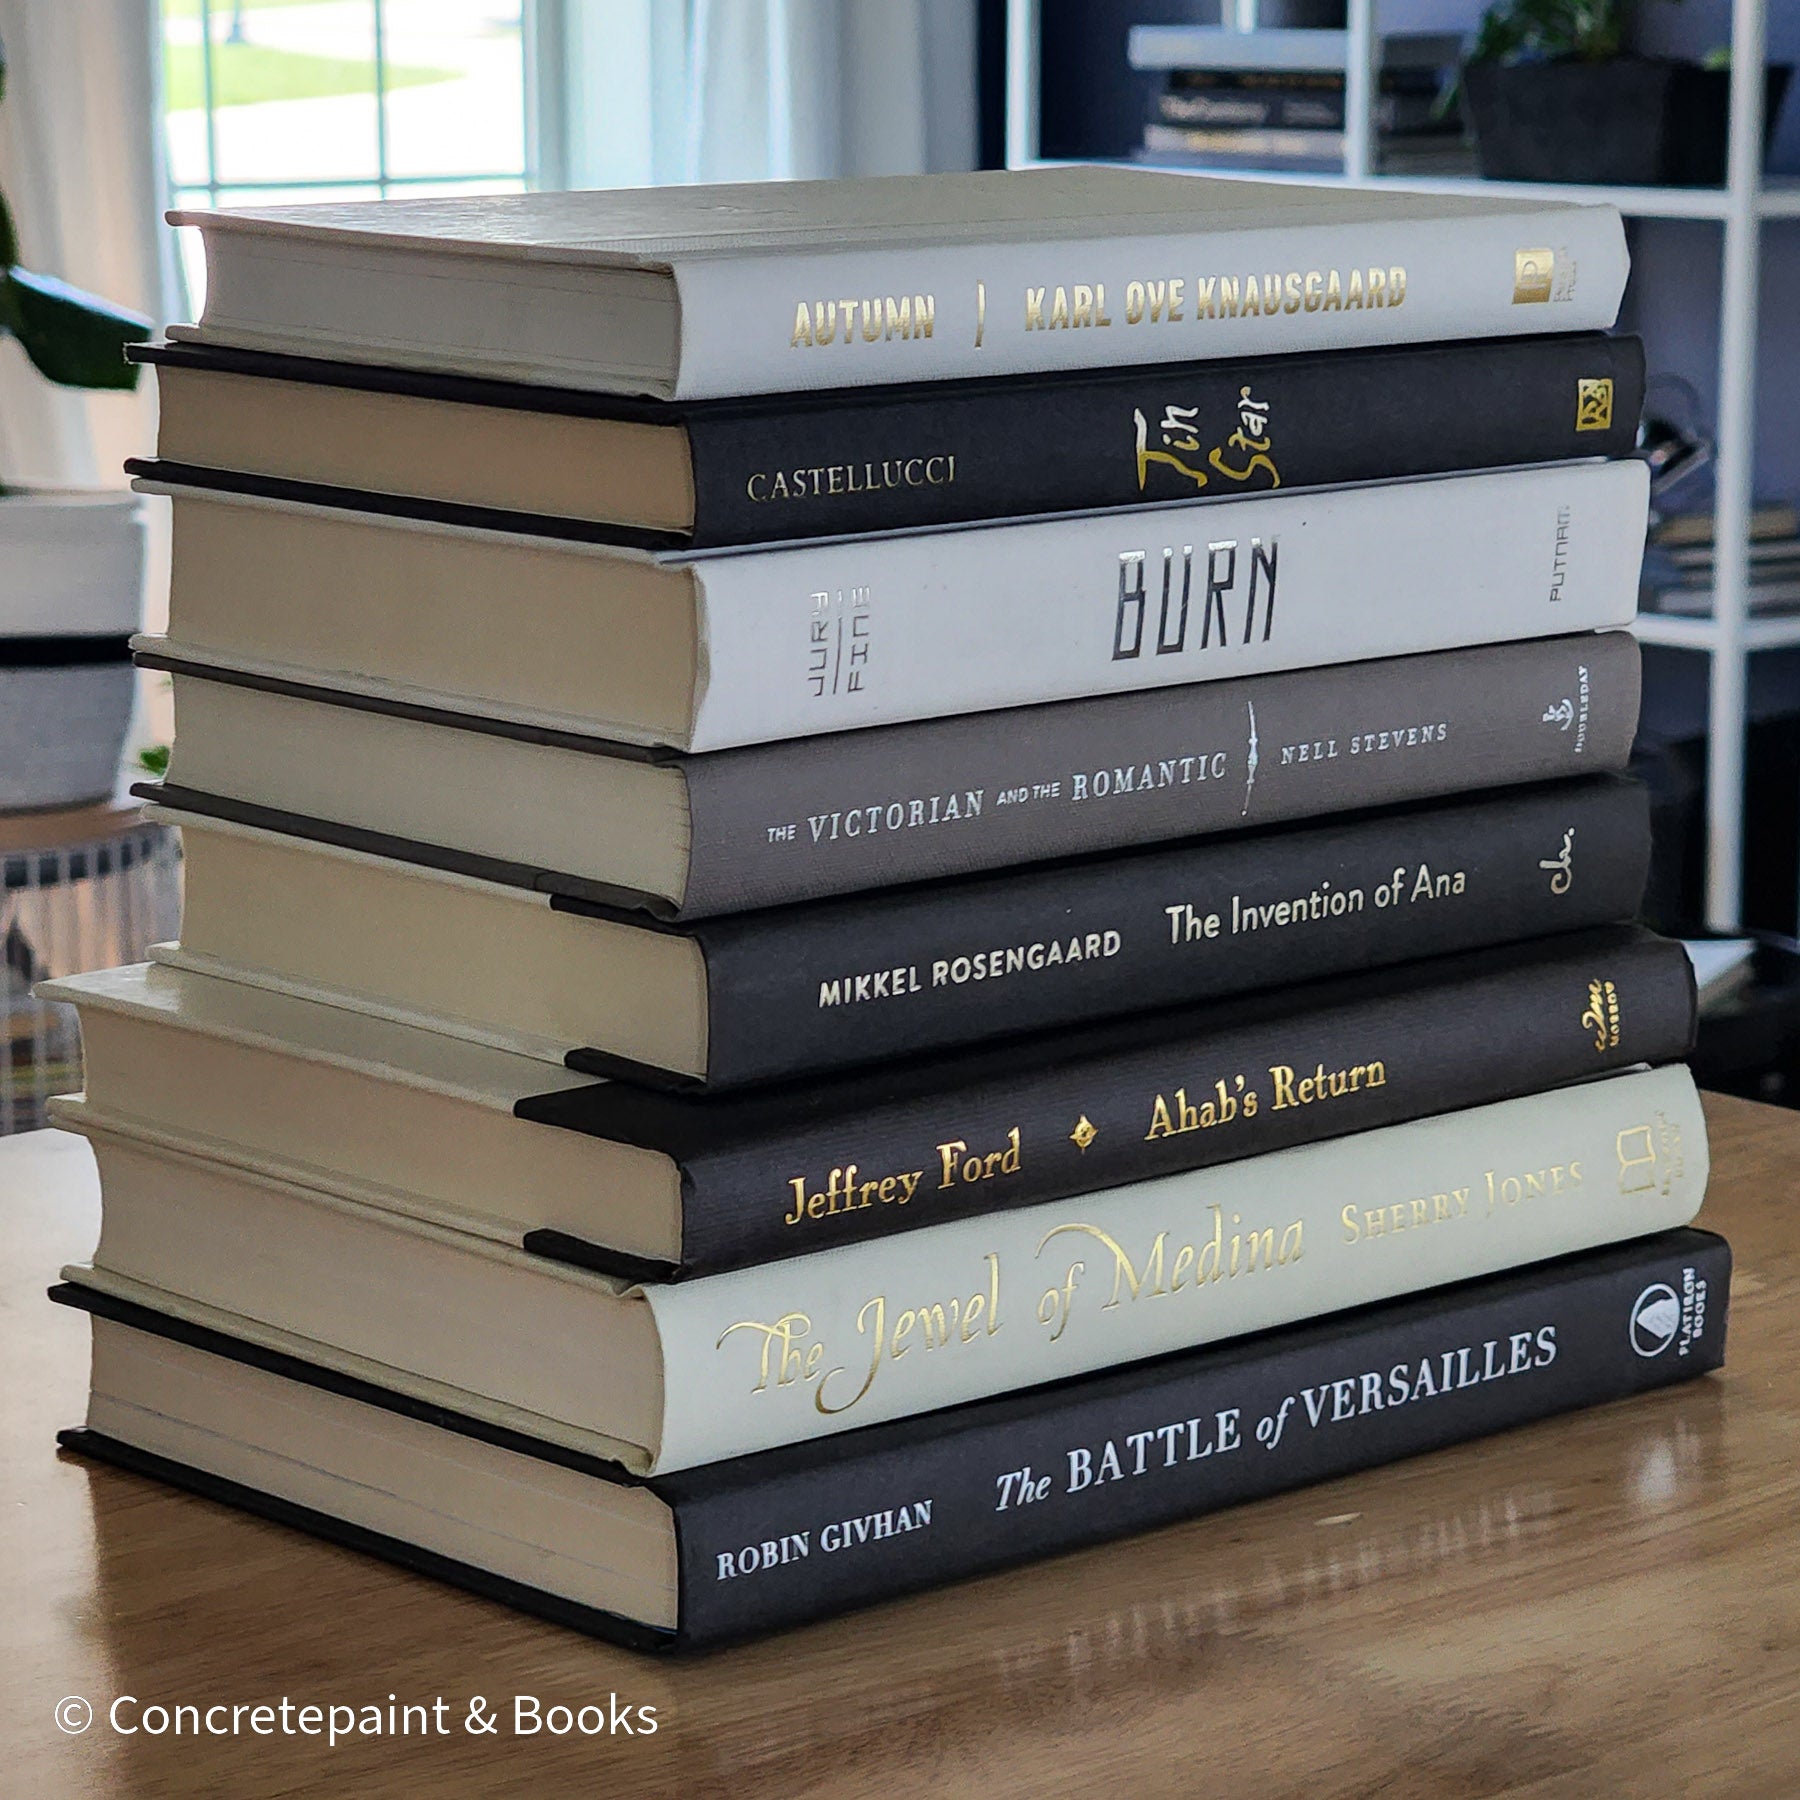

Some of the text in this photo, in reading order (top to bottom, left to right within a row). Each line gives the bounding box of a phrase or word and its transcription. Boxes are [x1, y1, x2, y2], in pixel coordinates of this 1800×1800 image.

[790, 294, 936, 349] AUTUMN
[1024, 266, 1408, 332] KARL OVE KNAUSGAARD
[1133, 404, 1208, 491] Tin
[1208, 386, 1281, 489] Star
[746, 455, 955, 502] CASTELLUCCI
[1111, 534, 1281, 662] BURN
[1280, 722, 1449, 766] NELL STEVENS
[767, 752, 1229, 843] THE VICTORIAN AND THE ROMANTIC
[1165, 864, 1467, 945] The Invention of Ana
[818, 930, 1123, 1009] MIKKEL ROSENGAARD
[1144, 1060, 1387, 1141] Ahab's Return
[784, 1126, 1022, 1226] Jeffrey Ford
[716, 1203, 1305, 1415] The Jewel of Medina
[995, 1326, 1557, 1511] The BATTLE of VERSAILLES
[716, 1500, 933, 1581] ROBIN GIVHAN
